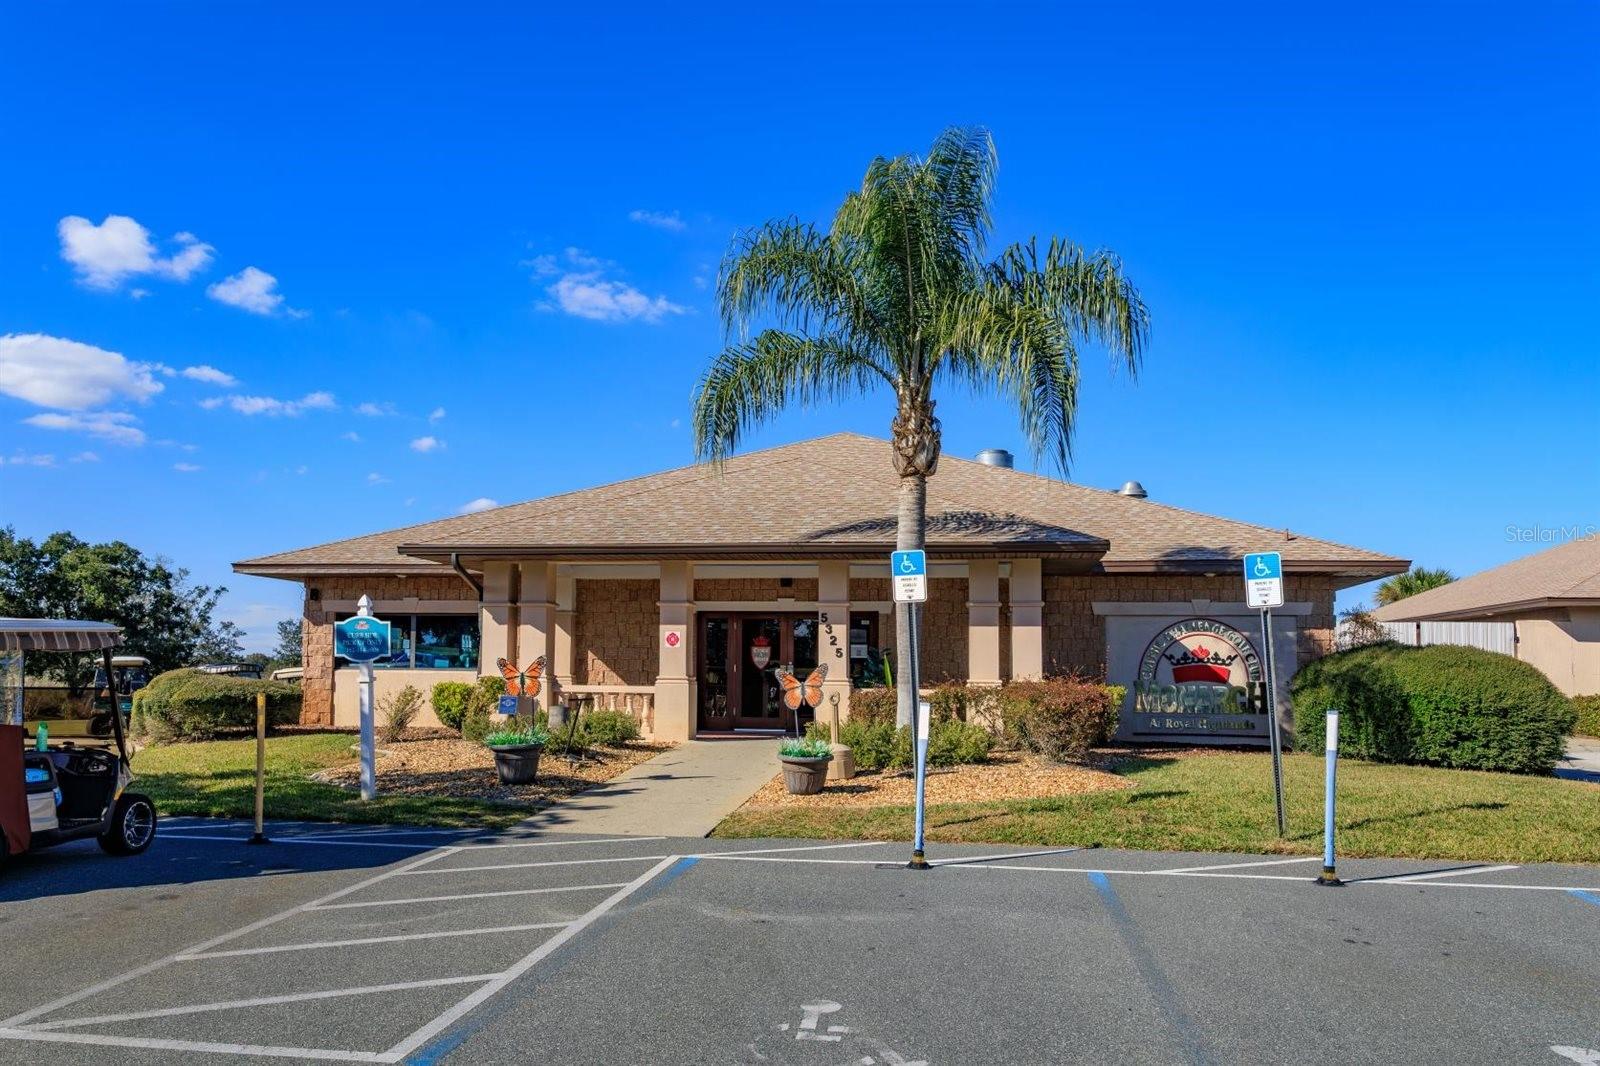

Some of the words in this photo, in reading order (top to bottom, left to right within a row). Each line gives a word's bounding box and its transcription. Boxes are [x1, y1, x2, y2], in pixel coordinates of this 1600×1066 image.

[820, 612, 844, 659] 5325
[1226, 630, 1251, 654] GOLF
[1133, 680, 1268, 715] MONARCH
